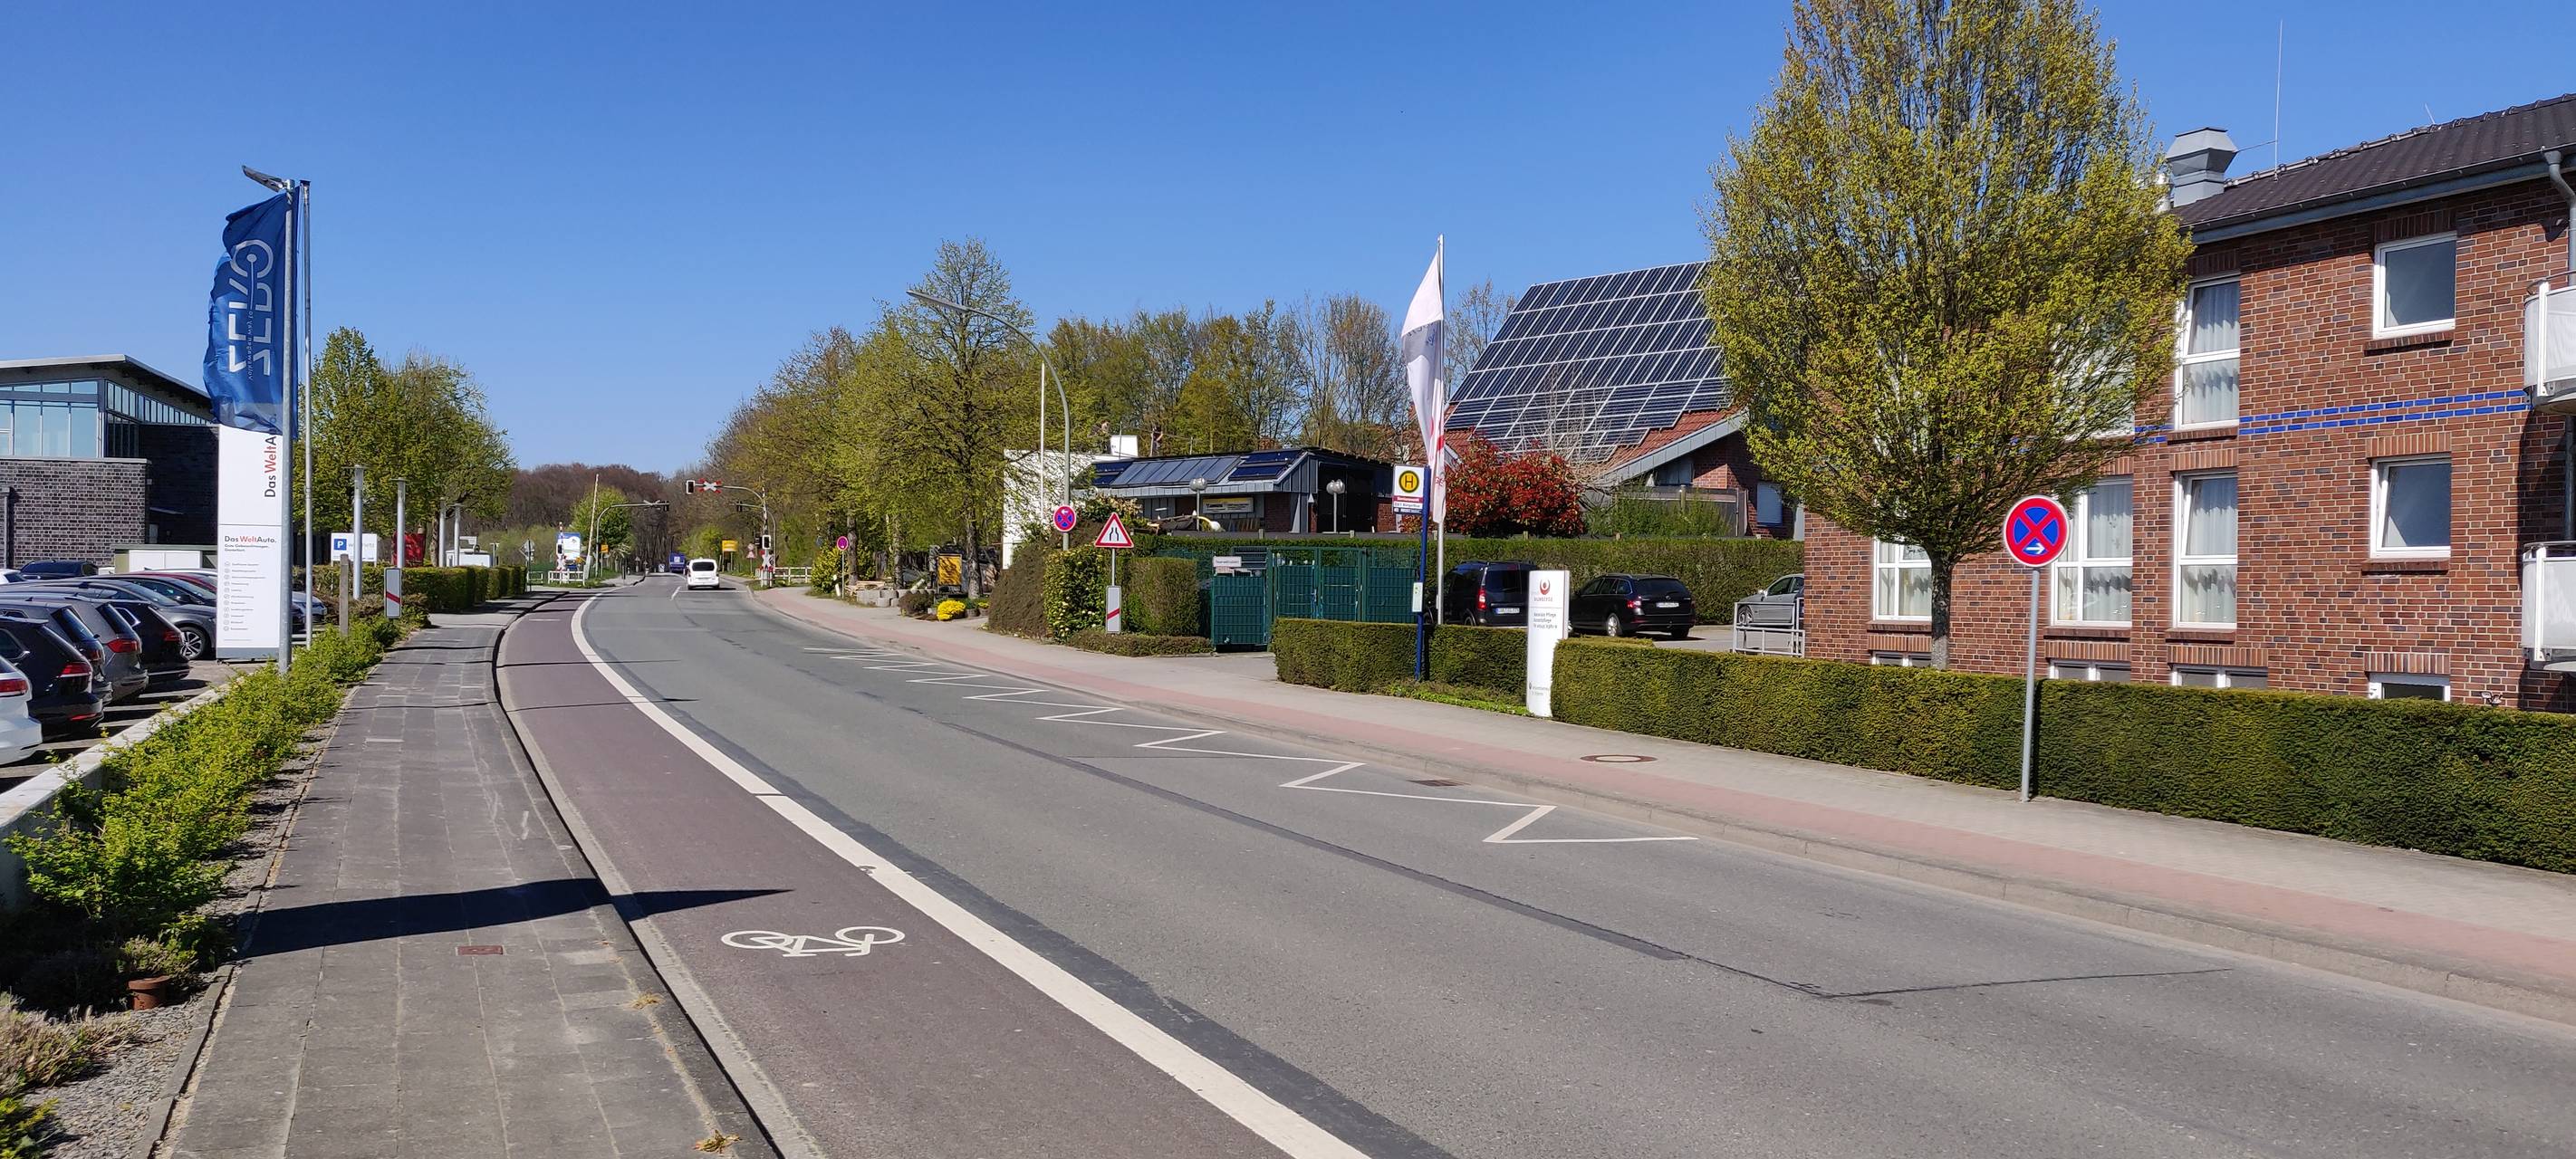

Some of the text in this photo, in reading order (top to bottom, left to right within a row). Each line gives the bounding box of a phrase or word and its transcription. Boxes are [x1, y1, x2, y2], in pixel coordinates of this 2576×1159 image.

[264, 475, 275, 498] Das
[1405, 475, 1413, 488] H
[239, 535, 277, 543] WeltAuto.
[337, 541, 344, 549] P
